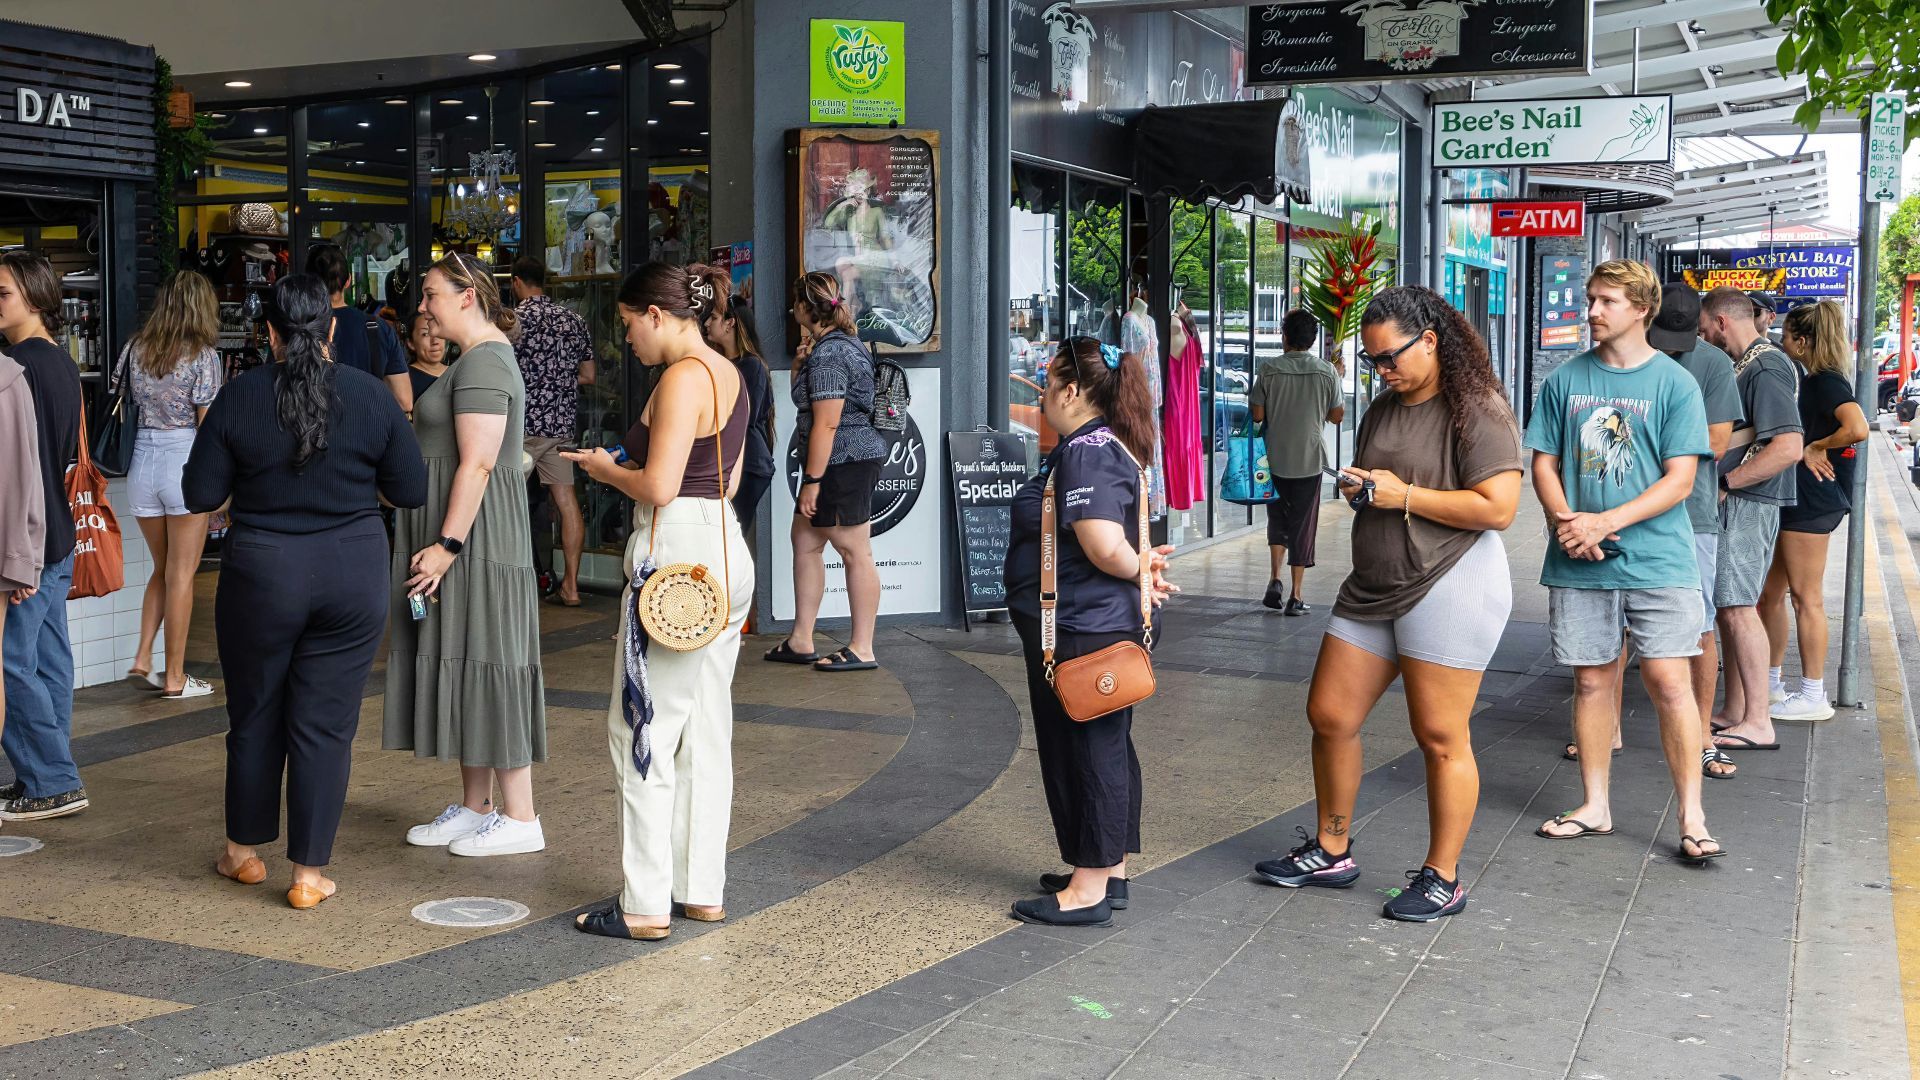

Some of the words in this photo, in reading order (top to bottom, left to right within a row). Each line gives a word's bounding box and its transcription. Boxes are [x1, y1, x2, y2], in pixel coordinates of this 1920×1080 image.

[1262, 4, 1326, 23] Gorgeous
[1490, 16, 1557, 39] Lingerie
[1261, 29, 1334, 47] Romantic
[1400, 39, 1438, 47] GRAFTON
[1491, 45, 1577, 63] Accessories
[1260, 57, 1338, 74] Irresistible
[818, 107, 847, 115] HOURS
[1522, 105, 1582, 130] Nail
[1874, 97, 1902, 124] 2P
[1331, 106, 1355, 160] Nail
[1874, 125, 1900, 136] TICKET
[1440, 136, 1550, 160] Garden
[1519, 208, 1576, 230] ATM
[1736, 251, 1809, 269] CRYSTAL
[1813, 251, 1853, 268] BALL
[1709, 270, 1759, 281] LUCKY
[1785, 266, 1839, 278] KSTORE
[1704, 280, 1764, 290] LOUNGE
[856, 312, 889, 331] Tea
[1608, 396, 1652, 423] COMPANY
[1044, 533, 1052, 571] MIMCO
